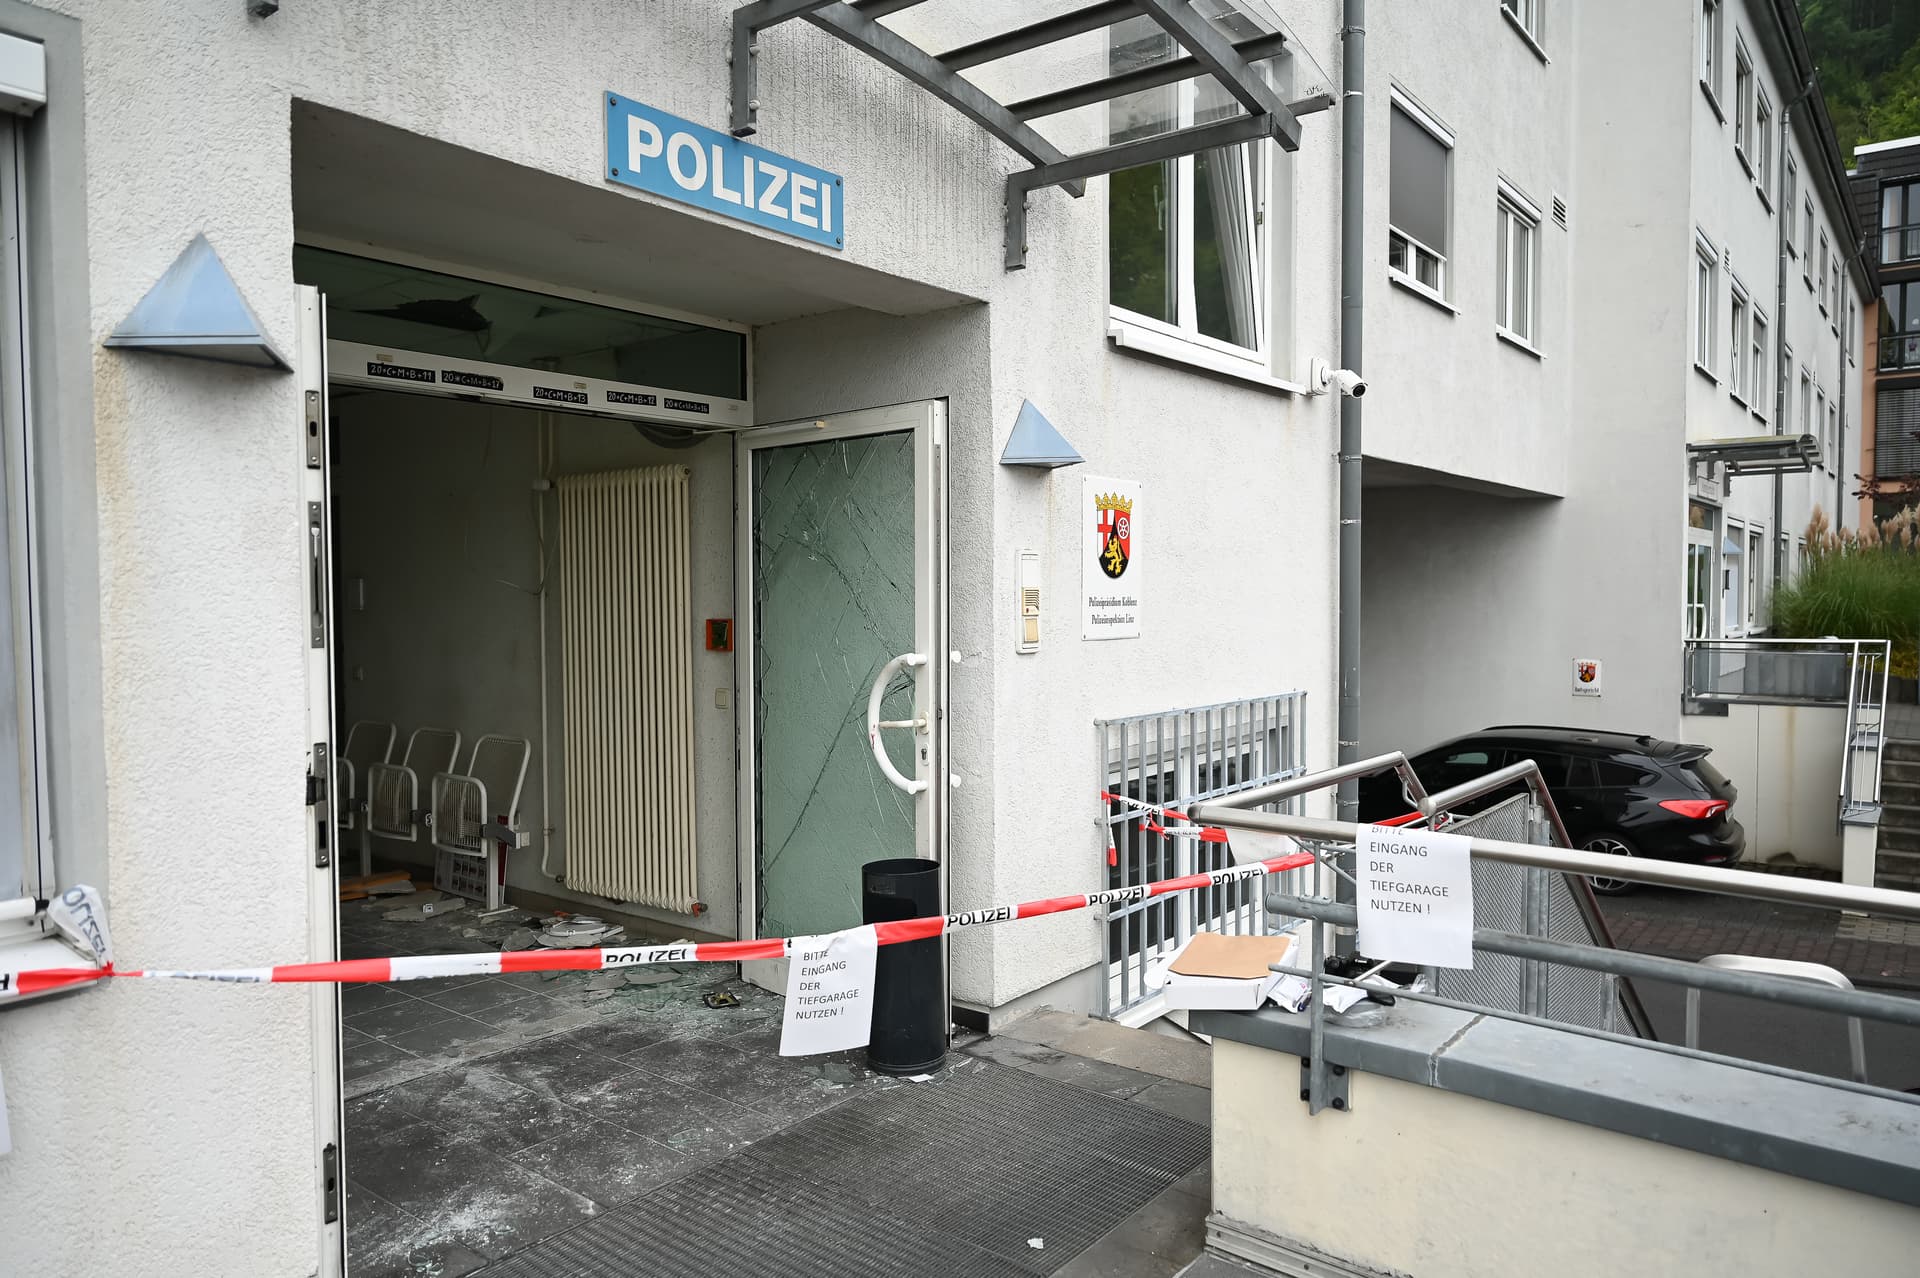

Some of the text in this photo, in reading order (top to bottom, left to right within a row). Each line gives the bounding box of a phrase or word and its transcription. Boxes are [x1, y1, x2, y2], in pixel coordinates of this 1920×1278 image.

[627, 114, 832, 233] POLIZEI
[1122, 596, 1137, 606] Koblenz
[1370, 841, 1428, 857] EINGANG
[1370, 861, 1394, 873] DER
[1089, 886, 1144, 906] POLIZEI
[1370, 880, 1449, 897] TIEFGARAGE
[1370, 899, 1422, 914] NUTZEN
[947, 906, 1010, 928] POLIZEI
[801, 961, 847, 976] EINGANG
[800, 981, 821, 991] DER
[798, 989, 859, 1005] TIEFGARAGE
[795, 1008, 837, 1020] NUTZEN
